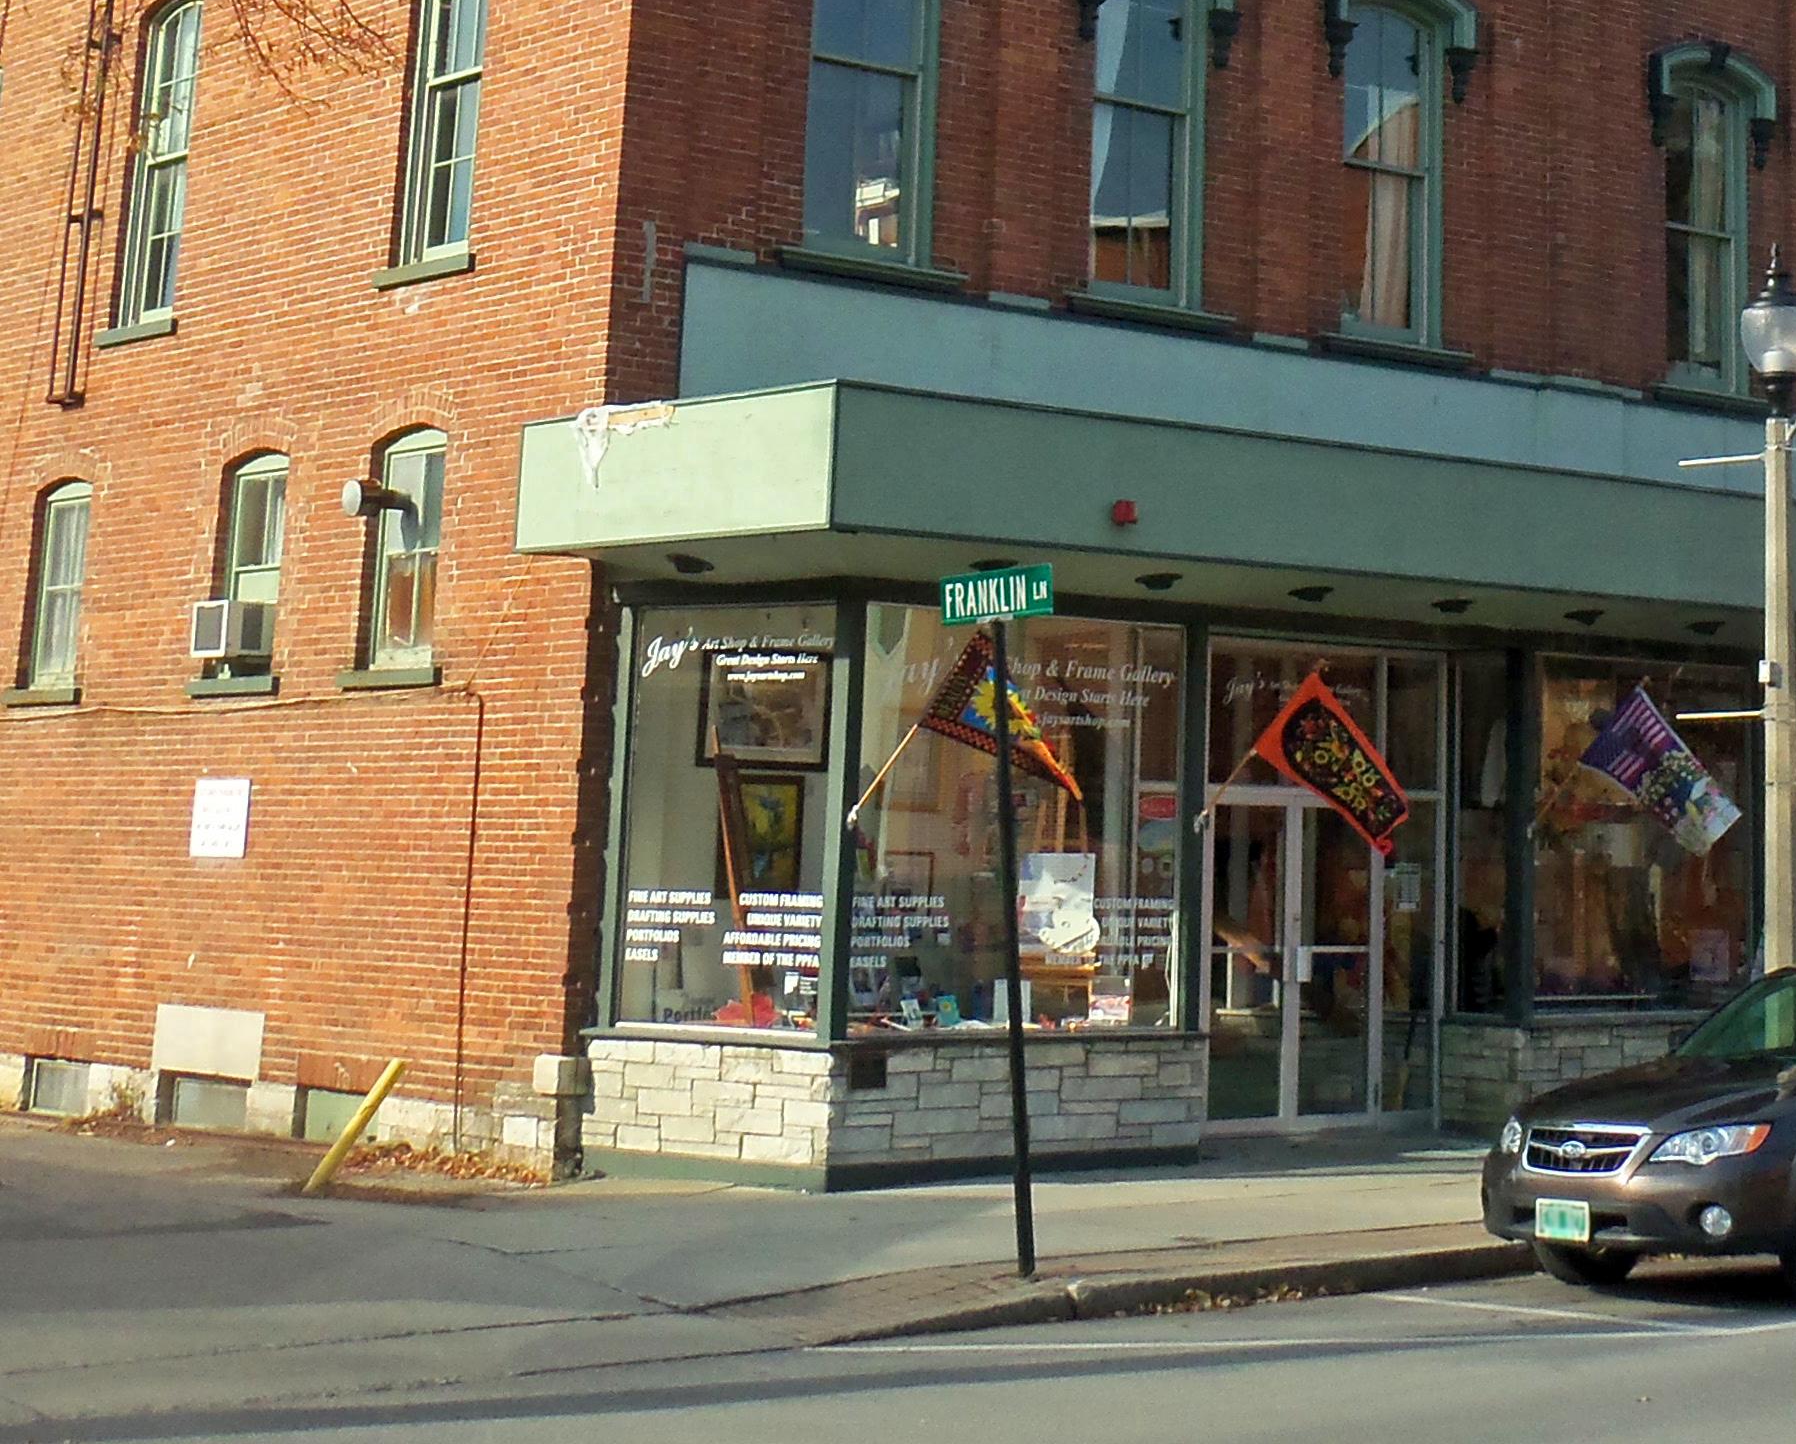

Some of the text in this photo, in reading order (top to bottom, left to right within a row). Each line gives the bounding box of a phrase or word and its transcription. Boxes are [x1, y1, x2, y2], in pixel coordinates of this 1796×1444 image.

[944, 574, 1048, 619] FRANKLIN LN
[641, 626, 835, 678] Jay's Art Shop & Frame Gallery
[715, 654, 741, 666] Great
[1045, 659, 1060, 677] &
[1064, 660, 1116, 681] Frame
[1120, 663, 1175, 689] Gallery
[1034, 685, 1079, 706] Design
[1080, 688, 1116, 706] Starts
[1120, 690, 1150, 707] Here
[628, 890, 712, 905] FINE ART SUPPLIES
[739, 893, 824, 907] CUSTOM FRAMING
[852, 896, 945, 908] FINE ART SUPPLIES
[1094, 898, 1132, 909] CUSTOM
[627, 909, 716, 924] DRAFTING SUPPLIES
[747, 912, 823, 928] UNIQUE VARIETY
[851, 916, 950, 928] DRAFTING SUPPLIES
[626, 929, 680, 943] PORTFOLIOS
[722, 931, 822, 948] AFFORDABLE PRICING
[850, 935, 911, 948] PORTFOLIOS
[625, 947, 659, 961] EASELS
[722, 951, 820, 968] MEMBER OF THE PPFA
[849, 956, 887, 968] EASELS
